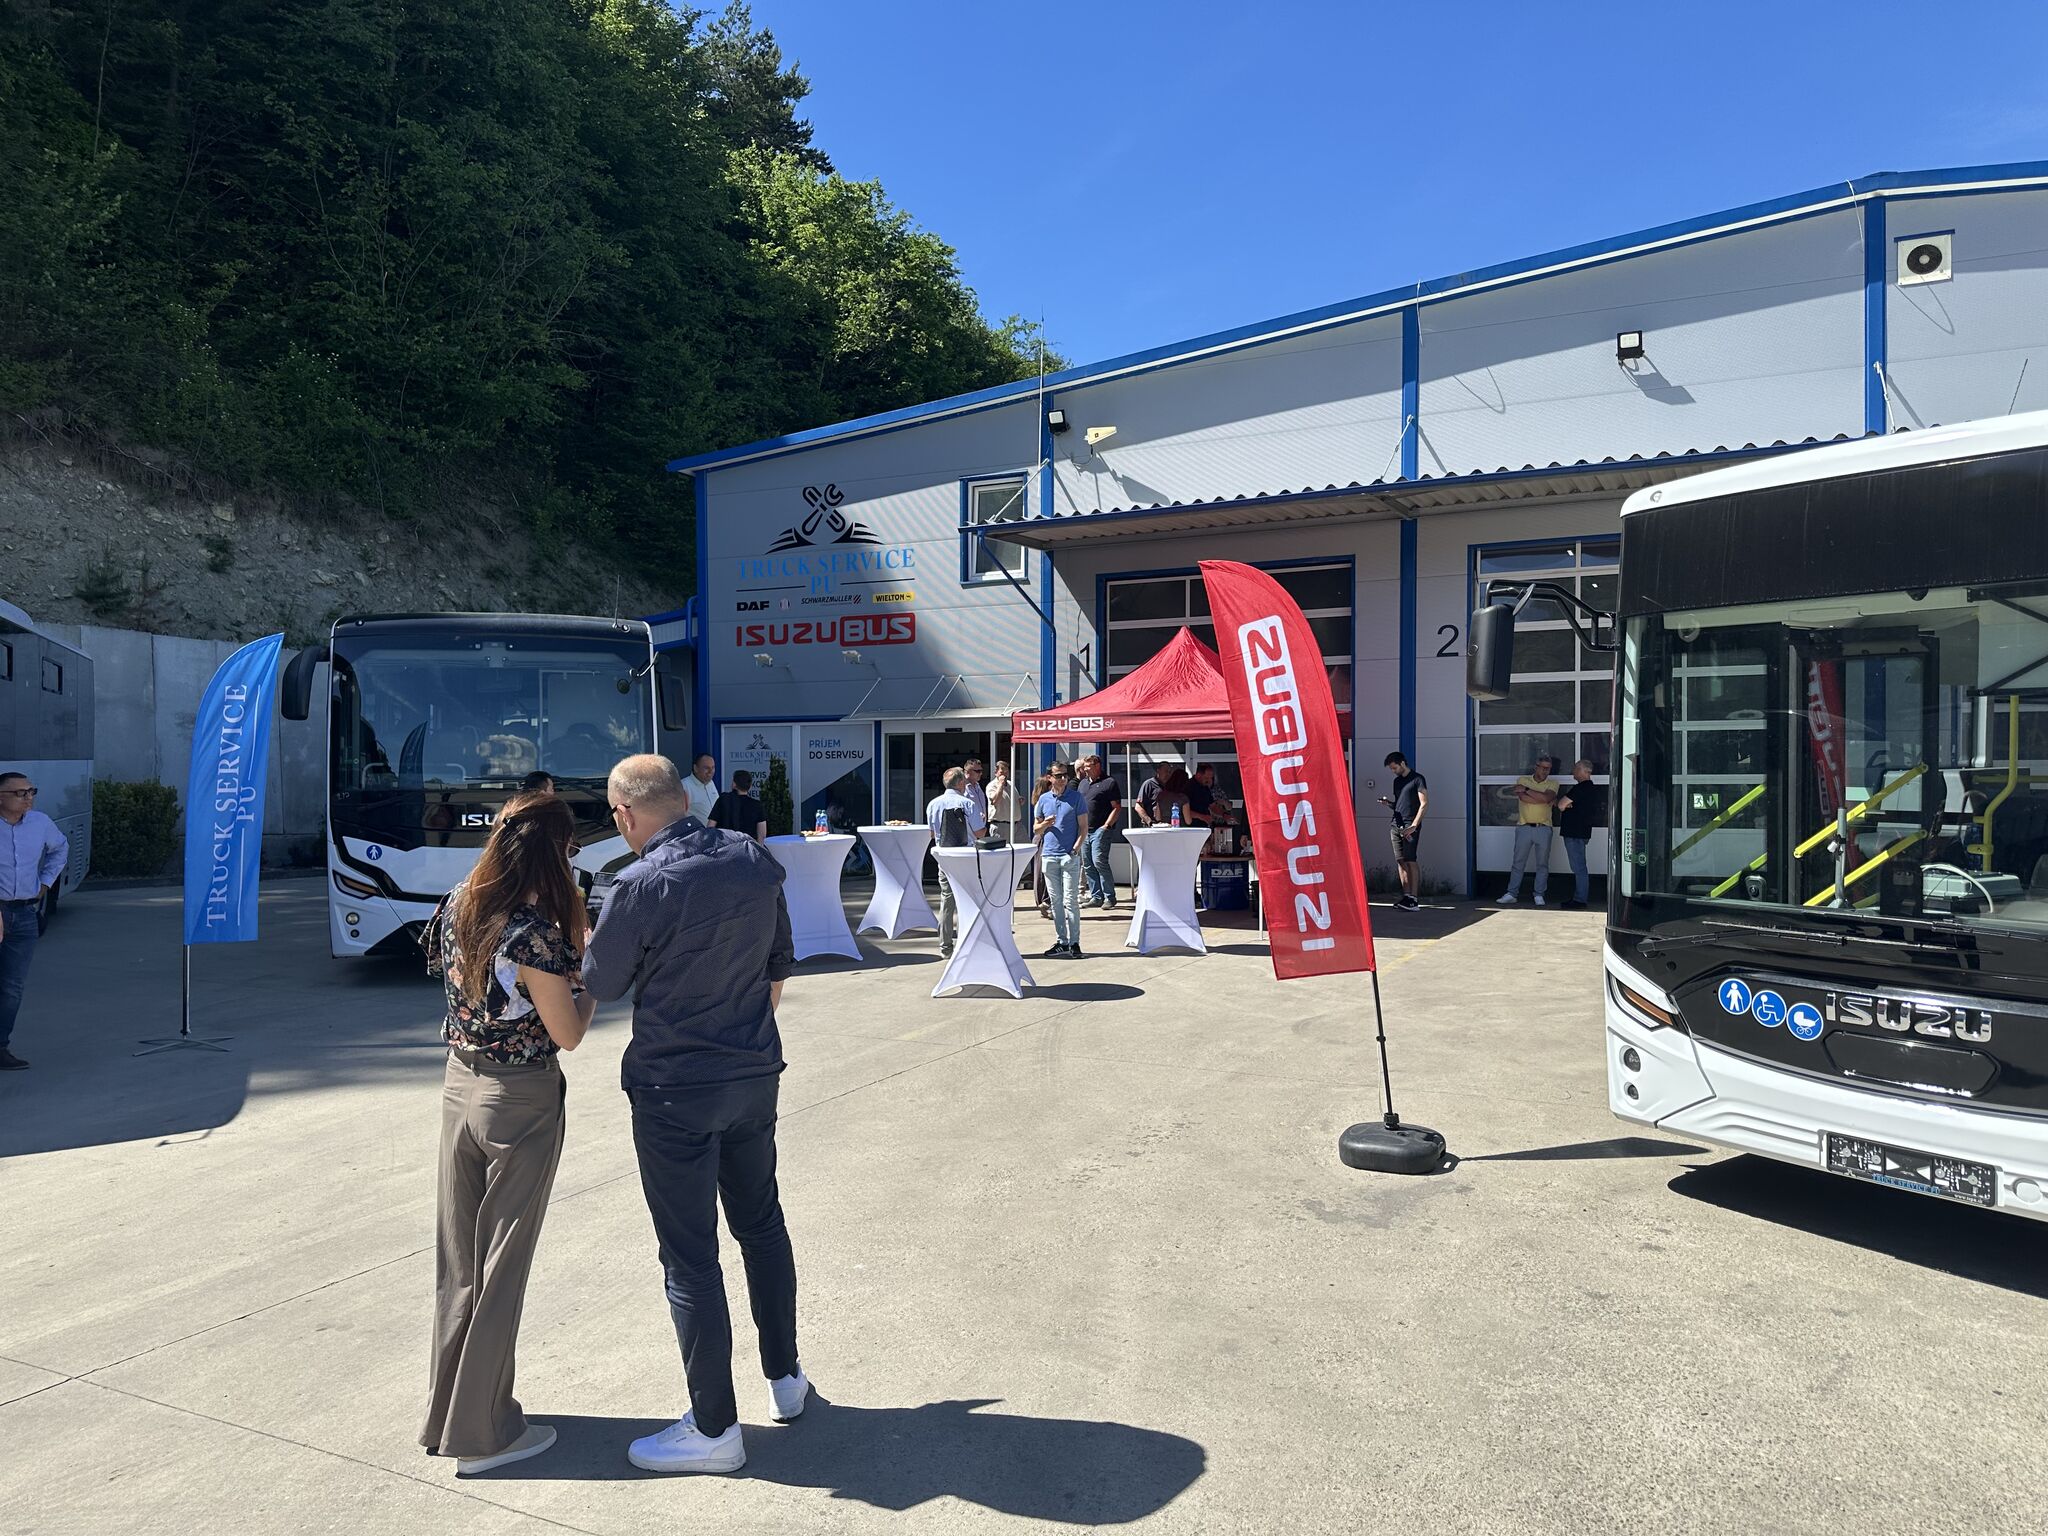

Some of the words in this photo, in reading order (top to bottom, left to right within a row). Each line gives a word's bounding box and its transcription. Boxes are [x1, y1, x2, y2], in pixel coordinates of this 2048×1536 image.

[736, 557, 810, 580] TRUCK
[812, 548, 916, 576] SERVICE
[810, 574, 838, 594] PU
[875, 593, 905, 603] WIELTON
[736, 600, 770, 612] DAF
[1437, 624, 1459, 657] 2
[1079, 642, 1090, 672] 1
[215, 683, 248, 813] SERVICE
[809, 737, 841, 749] PRÍJEM
[809, 751, 823, 760] DO
[825, 750, 864, 760] SERVISU
[236, 786, 257, 823] PU
[205, 821, 236, 928] TRUCK
[1211, 868, 1243, 877] DAF
[1825, 991, 1993, 1044] ISUZU
